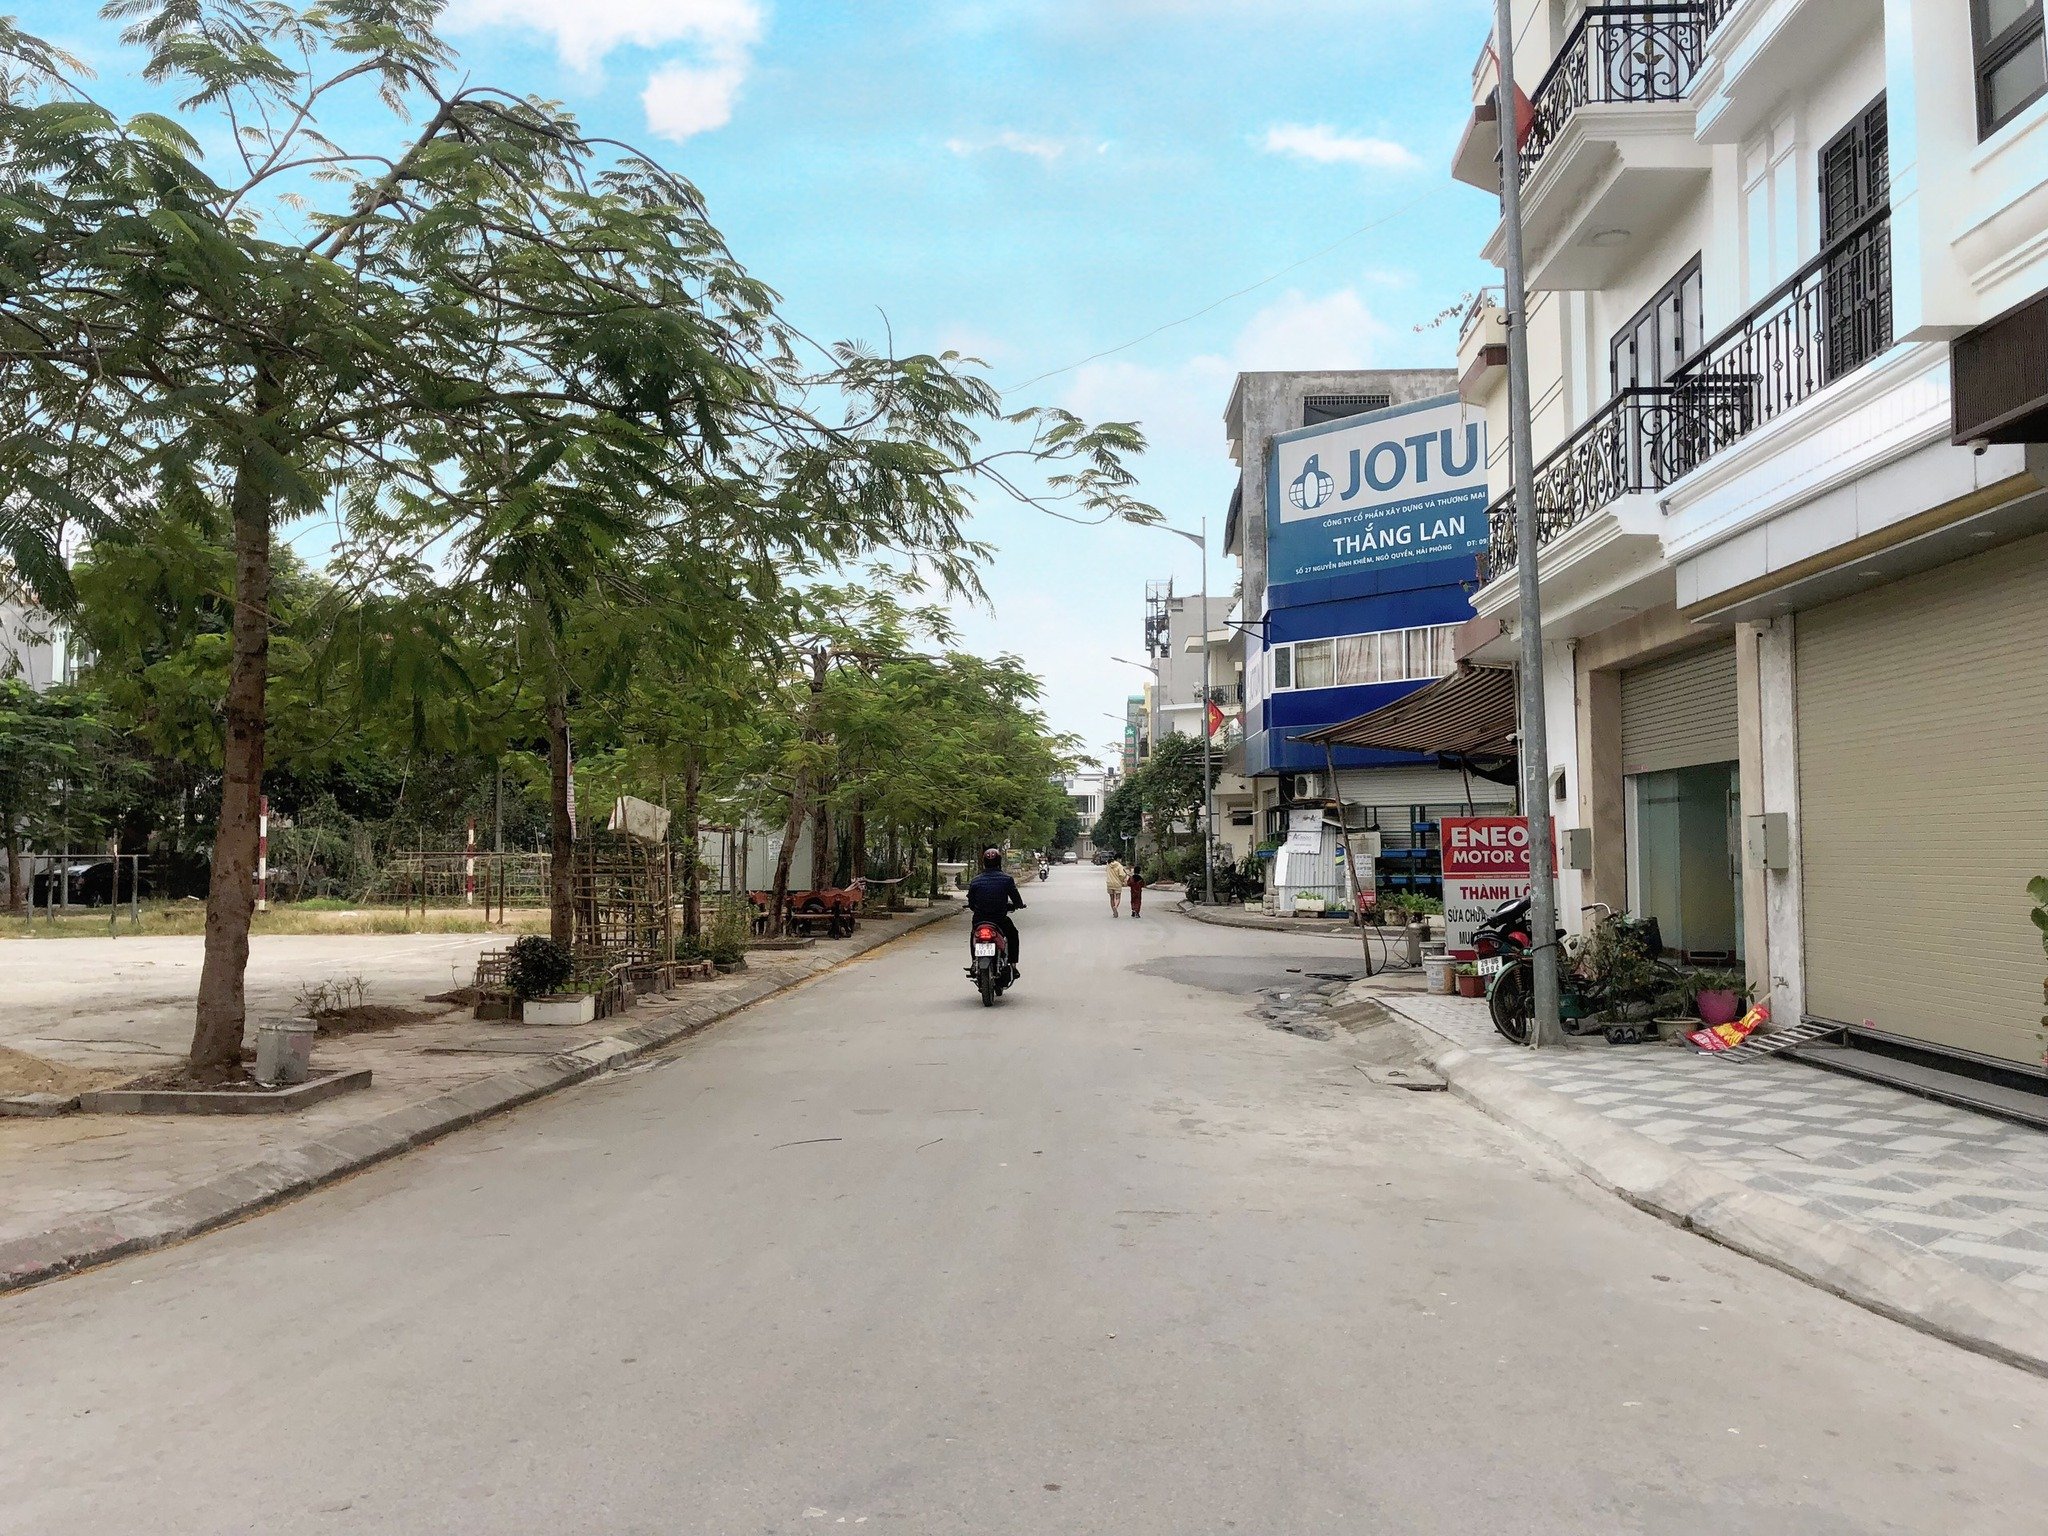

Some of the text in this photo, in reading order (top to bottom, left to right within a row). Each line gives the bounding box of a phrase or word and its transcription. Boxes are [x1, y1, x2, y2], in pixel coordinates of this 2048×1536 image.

[1340, 420, 1488, 501] JOTU
[1322, 518, 1342, 528] CÔNG
[1343, 516, 1351, 525] TY
[1385, 506, 1401, 516] XÂY
[1402, 502, 1423, 513] DỰNG
[1424, 500, 1436, 509] VÀ
[1437, 494, 1469, 507] THƯƠNG
[1332, 515, 1465, 556] THẮNG LAN
[1304, 566, 1311, 574] 27
[1428, 543, 1453, 553] PHÒNG
[1452, 849, 1515, 864] MOTOR
[1459, 884, 1510, 900] THÀNH
[1447, 905, 1464, 923] SỬA
